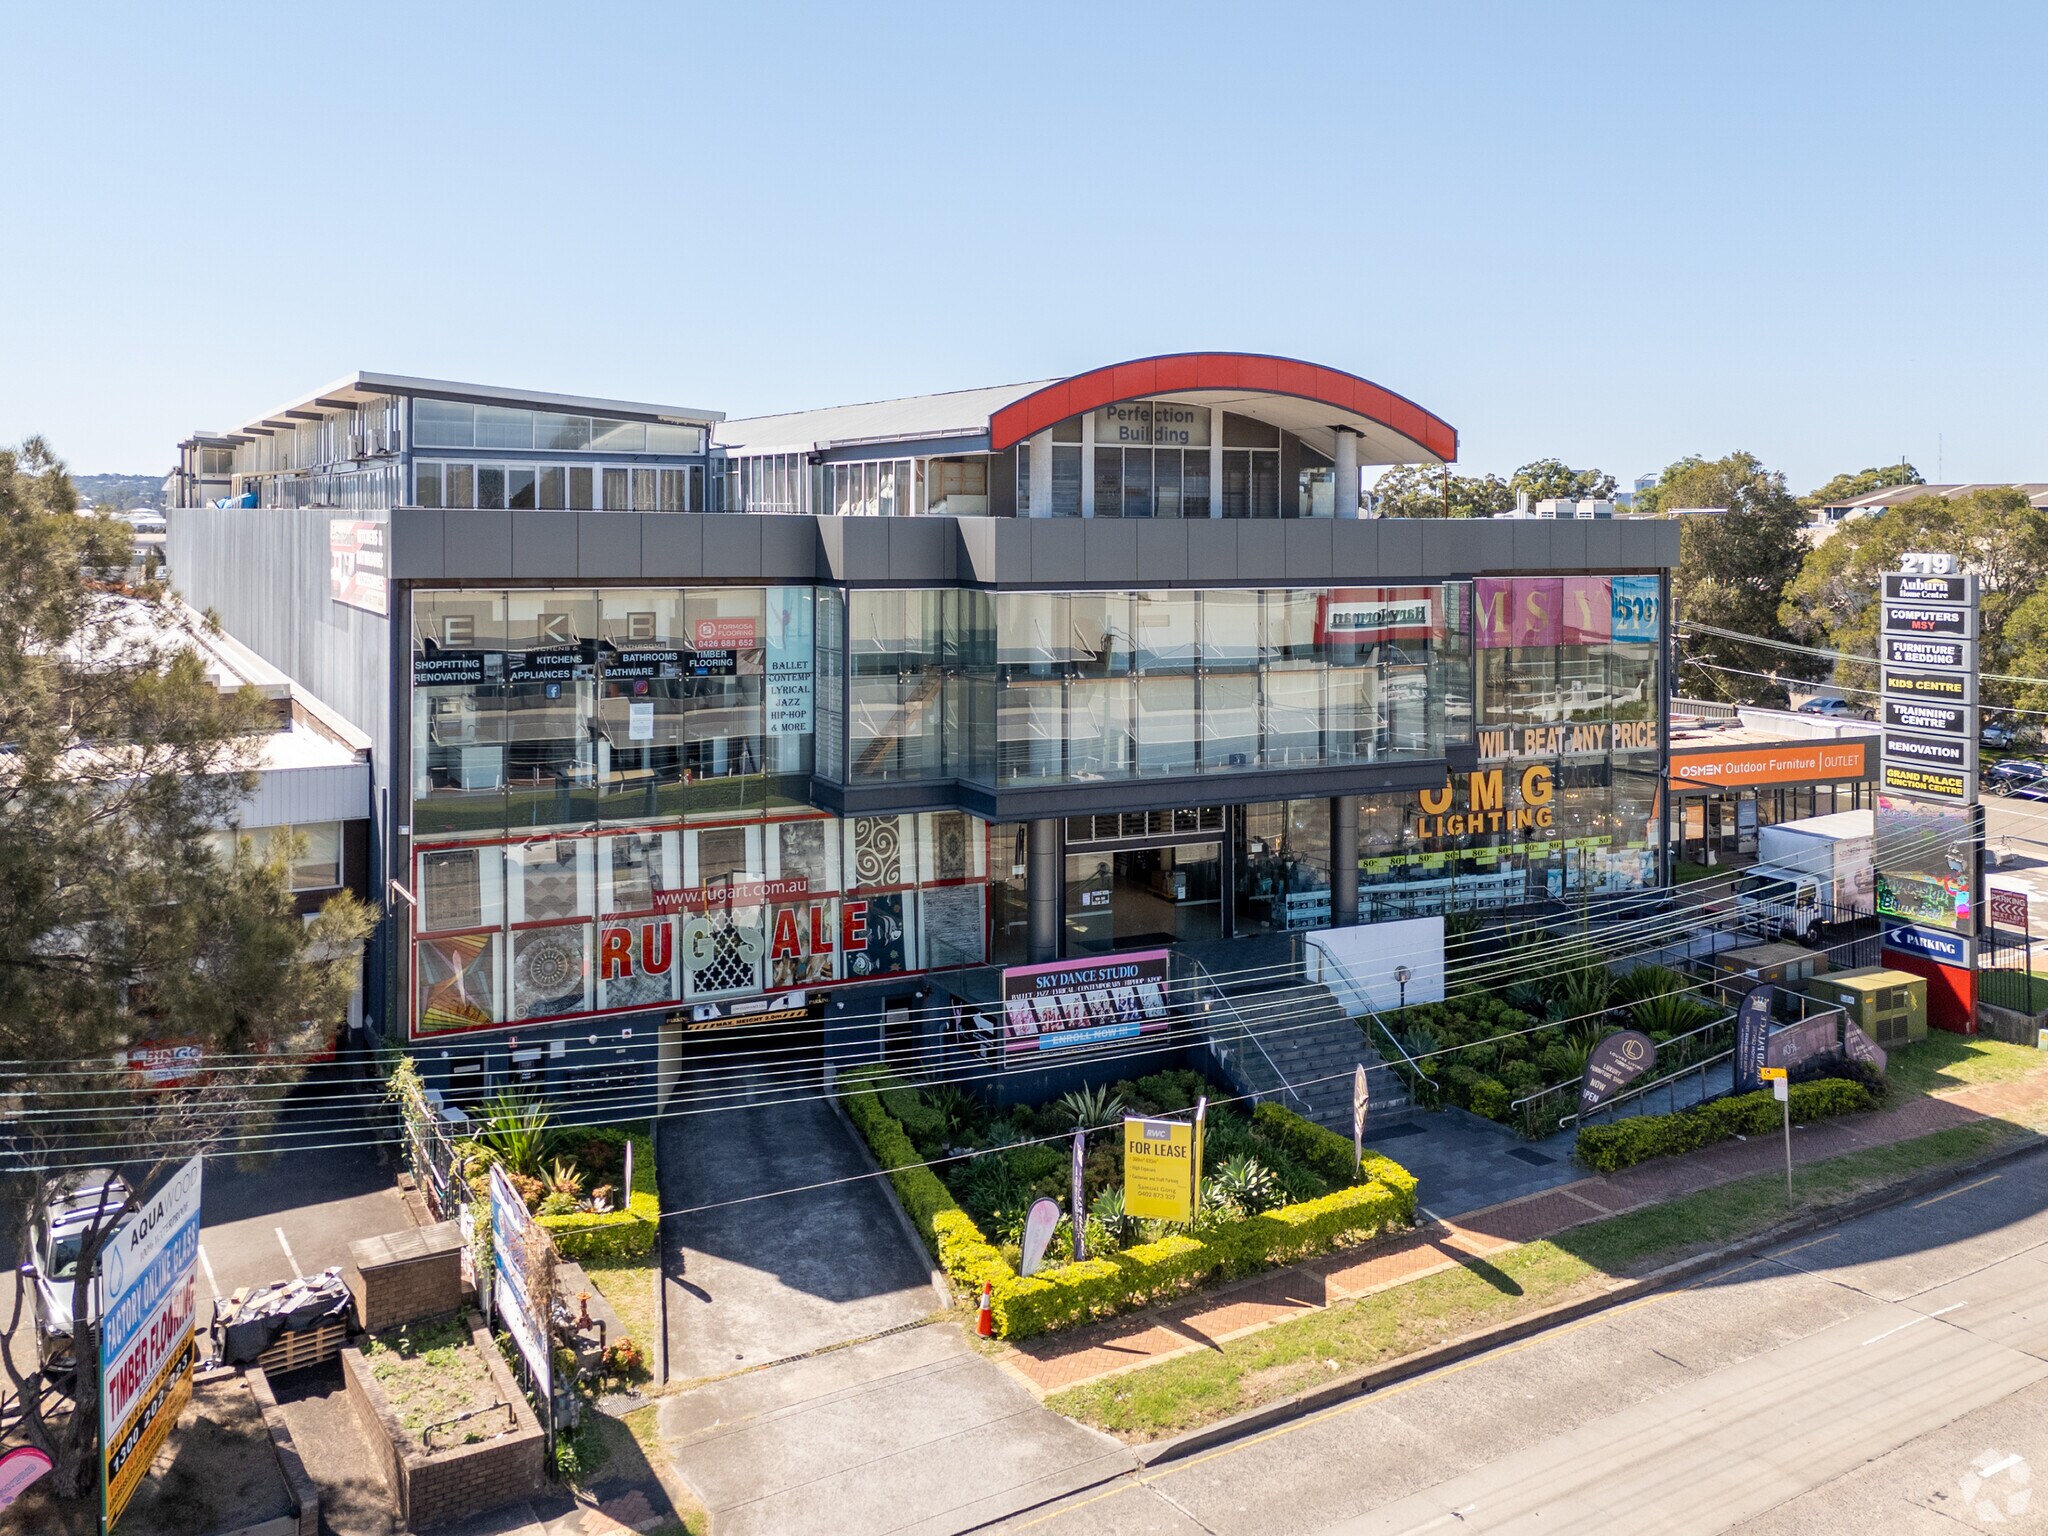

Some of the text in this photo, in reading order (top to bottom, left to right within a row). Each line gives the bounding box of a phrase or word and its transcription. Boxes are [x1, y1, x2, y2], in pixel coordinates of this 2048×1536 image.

[1107, 405, 1194, 423] Perfection
[1119, 425, 1189, 444] Building
[1900, 553, 1952, 574] 219
[1900, 578, 1948, 592] Auburn
[1922, 591, 1948, 599] Centre
[1891, 609, 1959, 622] COMPUTERS
[1911, 620, 1935, 630] MSY
[696, 650, 727, 659] TIMBER
[1893, 642, 1955, 655] FURNITURE
[537, 655, 582, 665] KITCHENS
[623, 653, 678, 662] BATHROOMS
[689, 659, 733, 667] FLOORING
[1894, 652, 1953, 664] & BEDDING
[415, 660, 480, 670] SHOPFITTING
[605, 667, 654, 677] BATHWARE
[772, 661, 808, 670] BALLET
[414, 671, 481, 682] RENOVATIONS
[511, 670, 570, 680] APPLIANCES
[769, 673, 811, 682] CONTEMP
[771, 685, 810, 694] LYRICAL
[1888, 678, 1962, 692] KIDS CENTRE
[776, 698, 800, 706] JAZZ
[771, 711, 807, 720] HIP-HOP
[1893, 704, 1955, 720] TRAINNING
[771, 723, 806, 732] & MORE
[1901, 715, 1945, 728] CENTRE
[1479, 722, 1657, 758] WILL BEAT ANY PRICE
[1888, 740, 1960, 758] RENOVATION
[1680, 754, 1859, 777] OSMEN Outdoor Furniture OUTLET
[1886, 768, 1962, 787] GRAND PALACE
[1886, 777, 1963, 795] FUNCTION CENTRE
[1418, 807, 1553, 838] LIGHTING
[656, 880, 807, 906] www.rugart.com.au
[1991, 894, 2026, 907] PARKING
[600, 900, 868, 981] RUG SALE
[1906, 934, 1956, 955] PARKING
[1036, 964, 1139, 990] SKY DANCE STUDIO
[1036, 989, 1049, 997] JAZZ
[736, 1016, 762, 1025] HEIGHT
[1052, 1033, 1089, 1045] ENROLL
[1093, 1028, 1117, 1040] NOW
[1602, 1063, 1622, 1077] LUXURY
[1590, 1078, 1607, 1092] NOW
[1147, 1129, 1166, 1137] RWC
[1130, 1141, 1187, 1158] FOR LEASE
[131, 1162, 197, 1252] AQUAWOOD
[107, 1283, 141, 1357] FACTORY
[143, 1247, 171, 1313] ONLINE
[109, 1272, 194, 1426] TIMBER FLOORING
[110, 1425, 124, 1456] BUY
[127, 1385, 151, 1431] DIRECT
[161, 1348, 177, 1381] SAVE
[113, 1425, 138, 1477] 1300
[144, 1386, 163, 1430] 202
